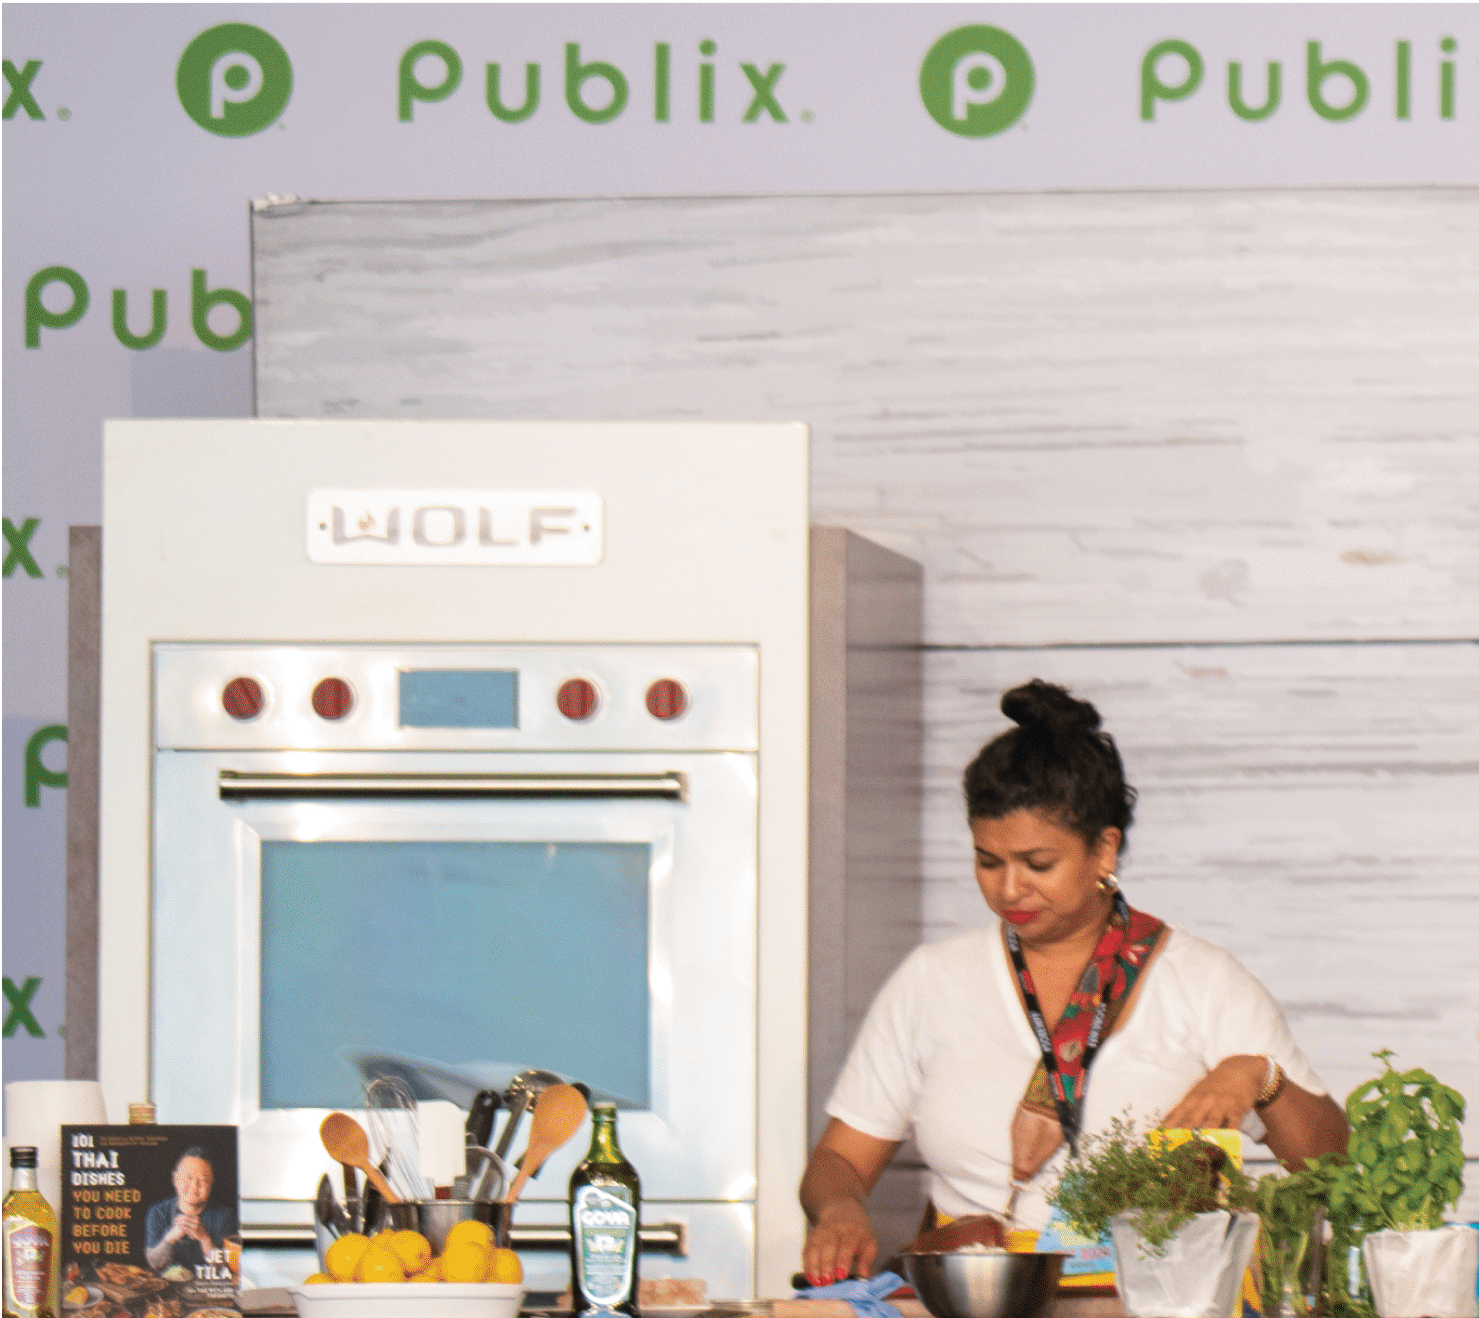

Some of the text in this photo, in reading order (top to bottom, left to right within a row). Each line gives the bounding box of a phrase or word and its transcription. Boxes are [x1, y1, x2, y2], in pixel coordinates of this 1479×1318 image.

[397, 38, 788, 124] Publix
[24, 265, 253, 351] Pub
[330, 504, 579, 548] WOLF
[71, 1133, 95, 1149] 101
[71, 1150, 120, 1169] THAI
[71, 1171, 126, 1187] DISHES
[71, 1189, 142, 1203] YOU NEED
[73, 1207, 132, 1220] TO COOK
[72, 1224, 127, 1238] BEFORE
[72, 1241, 130, 1255] YOU DIE
[194, 1264, 233, 1280] TILA
